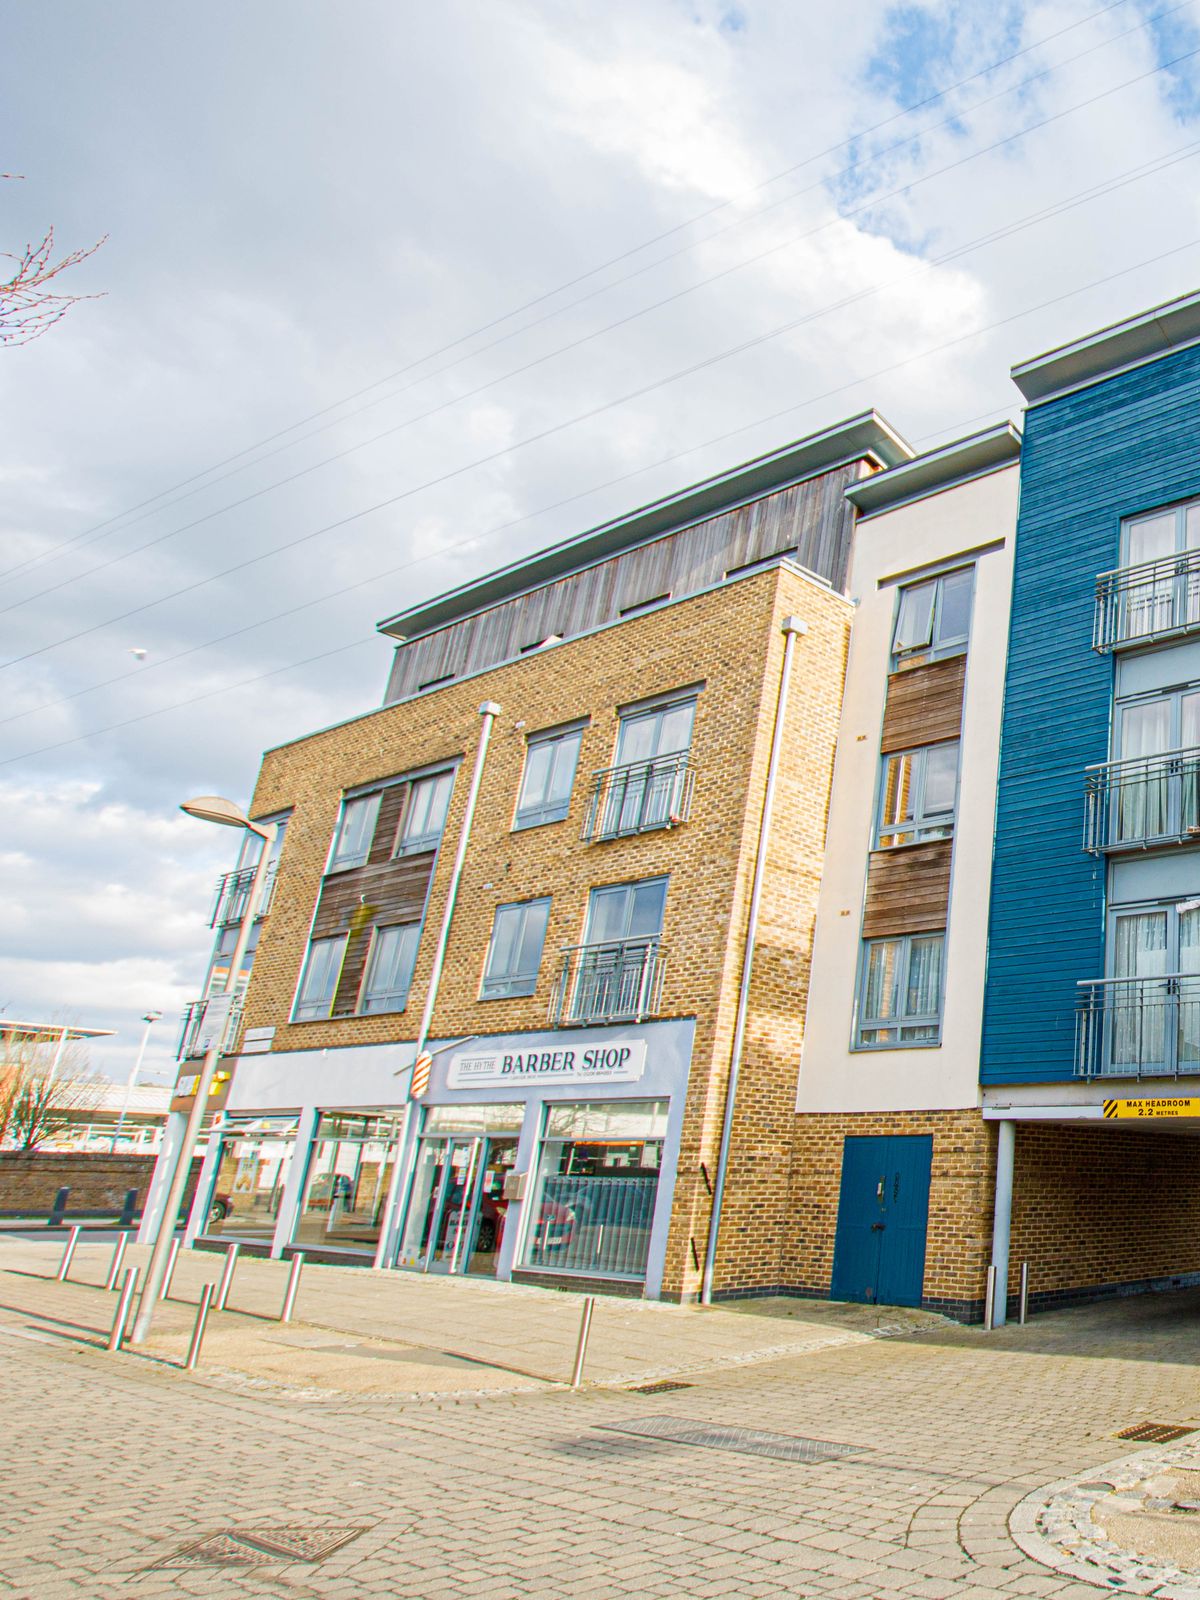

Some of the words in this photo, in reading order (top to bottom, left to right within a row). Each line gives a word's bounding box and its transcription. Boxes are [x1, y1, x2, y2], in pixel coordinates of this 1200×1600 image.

[501, 1051, 576, 1074] BARBER
[582, 1047, 631, 1070] SHOP
[460, 1062, 472, 1071] THE
[1138, 1108, 1154, 1116] 2.2
